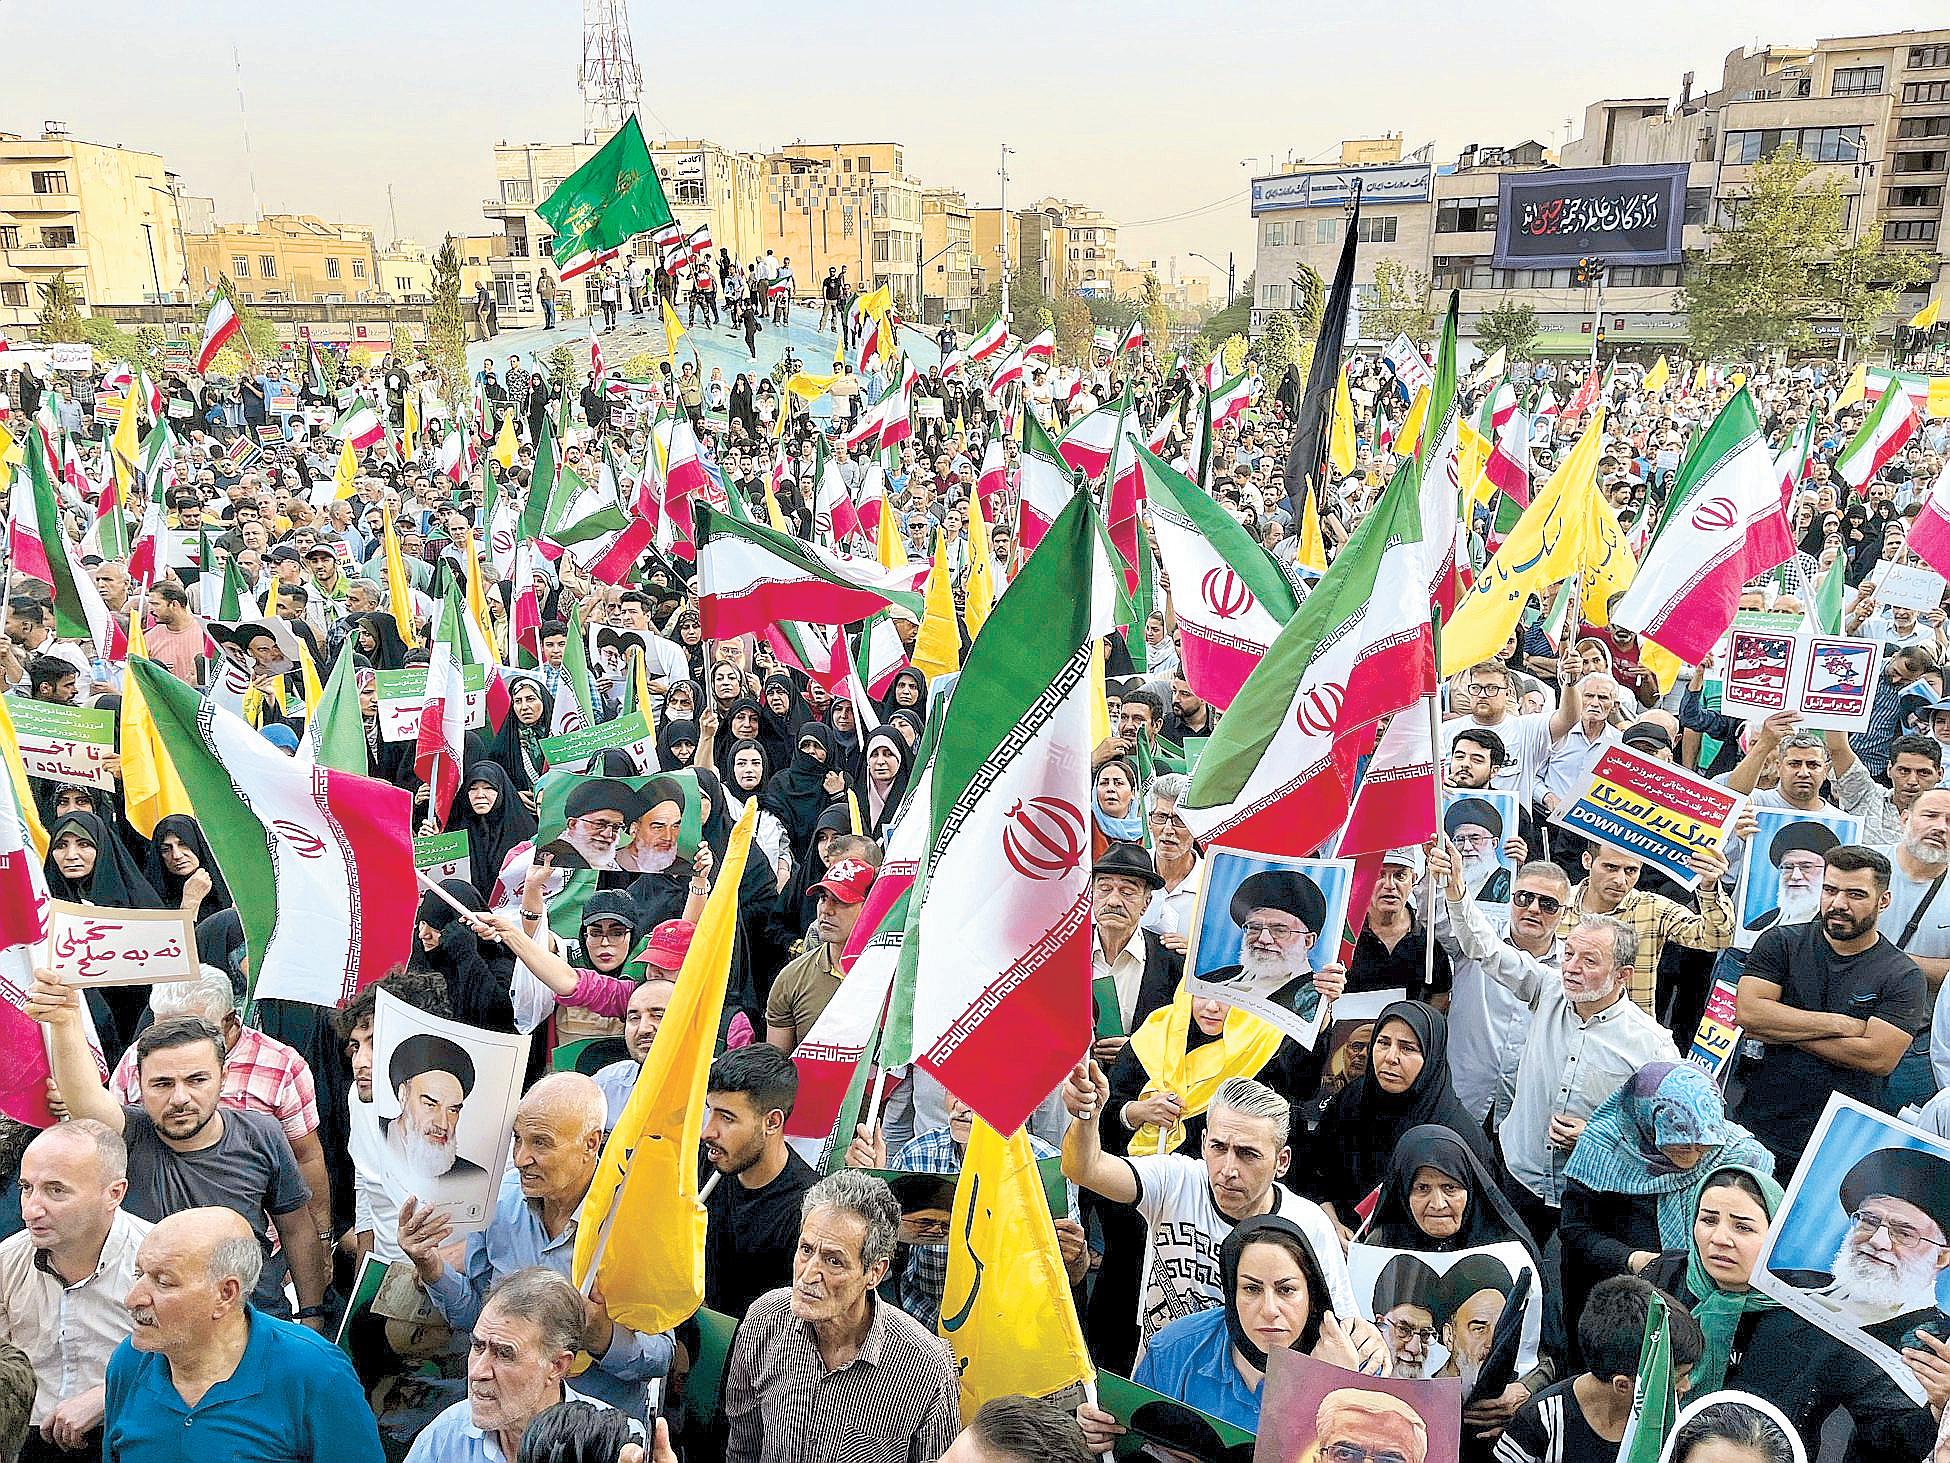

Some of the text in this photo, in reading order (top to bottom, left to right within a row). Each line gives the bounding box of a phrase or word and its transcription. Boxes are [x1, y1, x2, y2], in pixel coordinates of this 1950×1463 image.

[466, 694, 477, 706] تا
[1731, 688, 1756, 699] آمریکا
[1763, 692, 1780, 705] مرگ
[1844, 699, 1861, 710] مرگ
[86, 745, 101, 760] تا
[633, 742, 644, 756] تا
[36, 761, 101, 782] ایستاده
[1590, 783, 1717, 847] مرگ بر آمریکا
[1571, 806, 1692, 869] DOWN WITH US
[442, 863, 457, 876] تا
[55, 920, 181, 977] نه به صلح تحمیلی
[1697, 1023, 1731, 1050] مرگ
